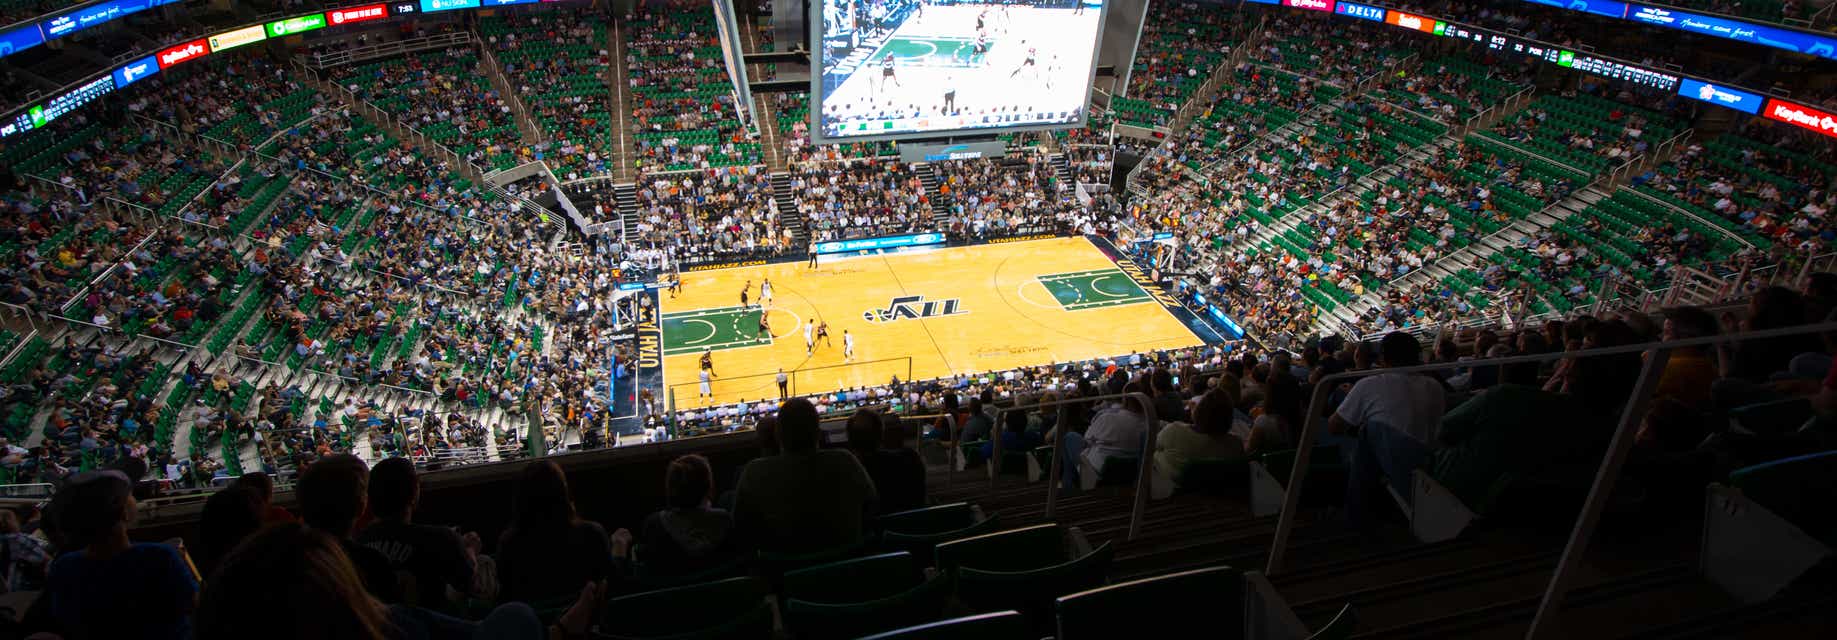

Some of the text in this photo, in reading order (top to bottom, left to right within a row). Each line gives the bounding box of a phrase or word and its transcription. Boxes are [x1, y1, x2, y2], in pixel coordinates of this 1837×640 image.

[1347, 5, 1383, 19] DELTA
[1774, 105, 1820, 127] KeyBank
[1116, 260, 1154, 283] UTAH
[639, 335, 659, 368] UTAH
